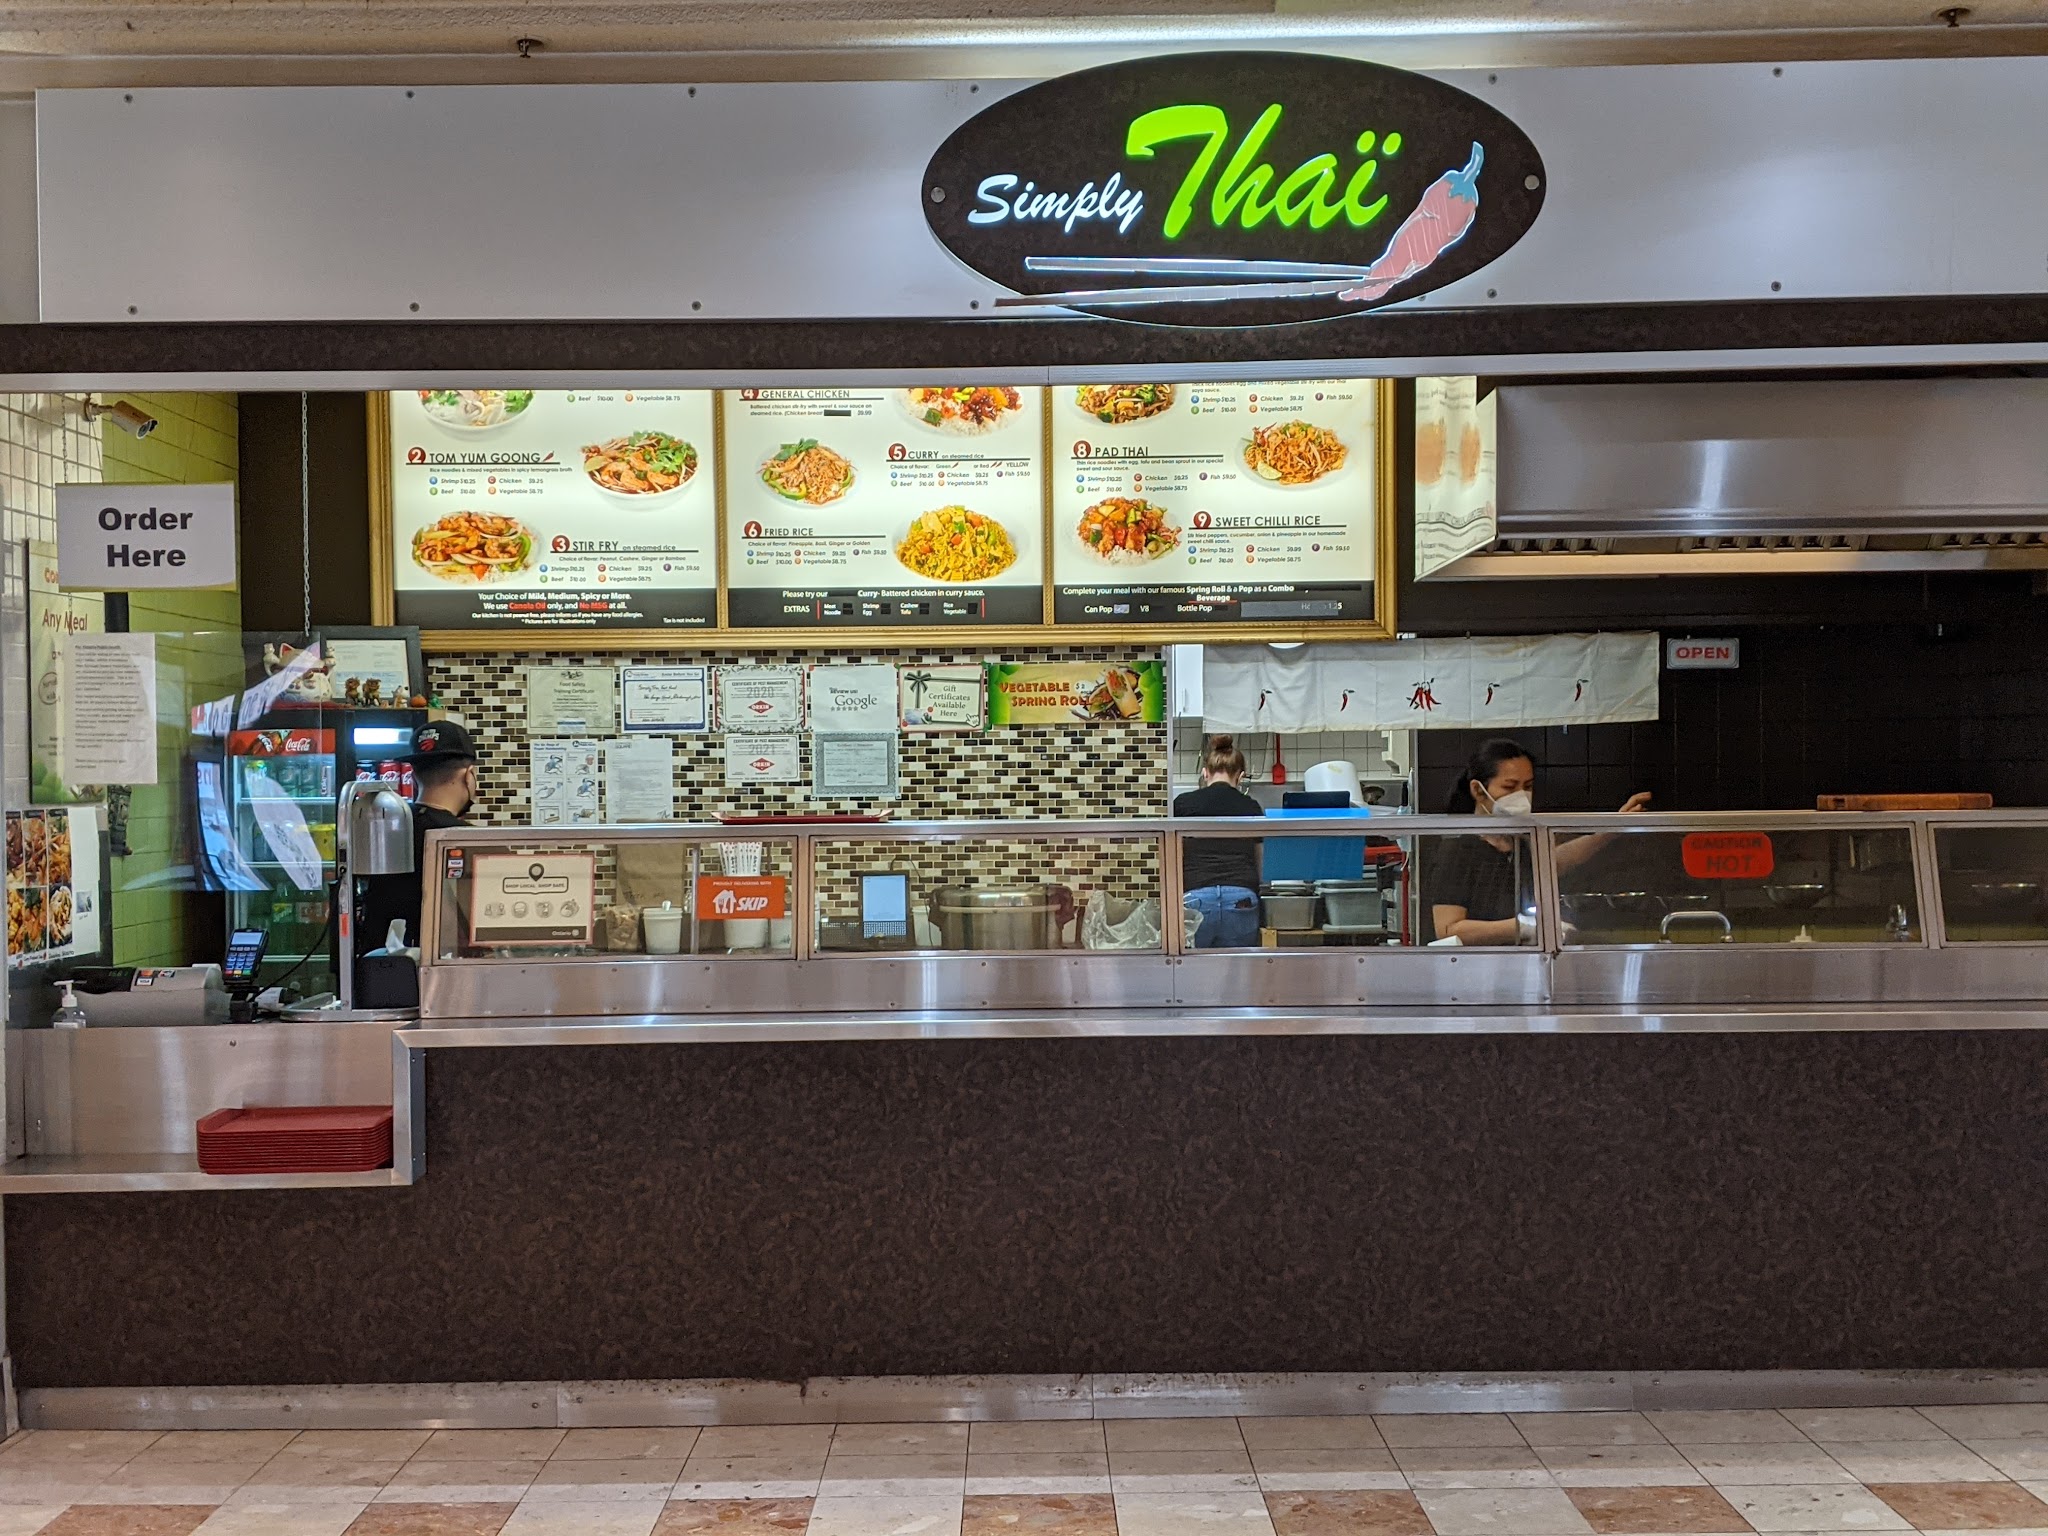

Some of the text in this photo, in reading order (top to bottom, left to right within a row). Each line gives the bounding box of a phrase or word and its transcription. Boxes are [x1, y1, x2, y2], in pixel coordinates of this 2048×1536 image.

[968, 172, 1143, 234] Simply
[744, 390, 754, 399] 4
[807, 390, 850, 398] CHICKEN
[411, 449, 541, 463] 2 TOM YUM GOONG
[894, 446, 903, 461] 5
[908, 451, 939, 459] CURRY
[1077, 443, 1148, 457] 8 PAD THAI
[98, 507, 193, 530] Order
[1199, 513, 1320, 528] 9 SWEET CHILLI RICE
[749, 524, 757, 537] 6
[557, 538, 565, 551] 3
[573, 542, 594, 550] STIR
[599, 541, 619, 550] FRY
[107, 544, 186, 567] Here
[520, 592, 527, 600] of
[528, 592, 546, 601] Mild,
[548, 592, 579, 601] Medium,
[581, 592, 600, 601] Spicy
[1063, 588, 1095, 596] Complete
[1132, 586, 1146, 594] with
[1160, 586, 1185, 594] famous
[1187, 586, 1210, 596] Spring
[1212, 586, 1226, 594] Roll
[1239, 586, 1253, 594] Pop
[1197, 594, 1230, 603] Beverage
[547, 602, 563, 610] only,
[1099, 606, 1112, 614] Pop
[1199, 605, 1212, 613] Pop
[42, 608, 62, 632] Any
[1676, 647, 1730, 658] OPEN
[747, 687, 774, 697] 2020
[1000, 682, 1070, 693] VEGETABLE
[835, 694, 877, 709] Google
[929, 693, 970, 701] Certificates
[1012, 696, 1056, 706] SPRING
[749, 744, 775, 755] 2021
[1692, 838, 1762, 849] CAUTION
[1706, 856, 1754, 872] HOT
[737, 897, 768, 910] SKIP
